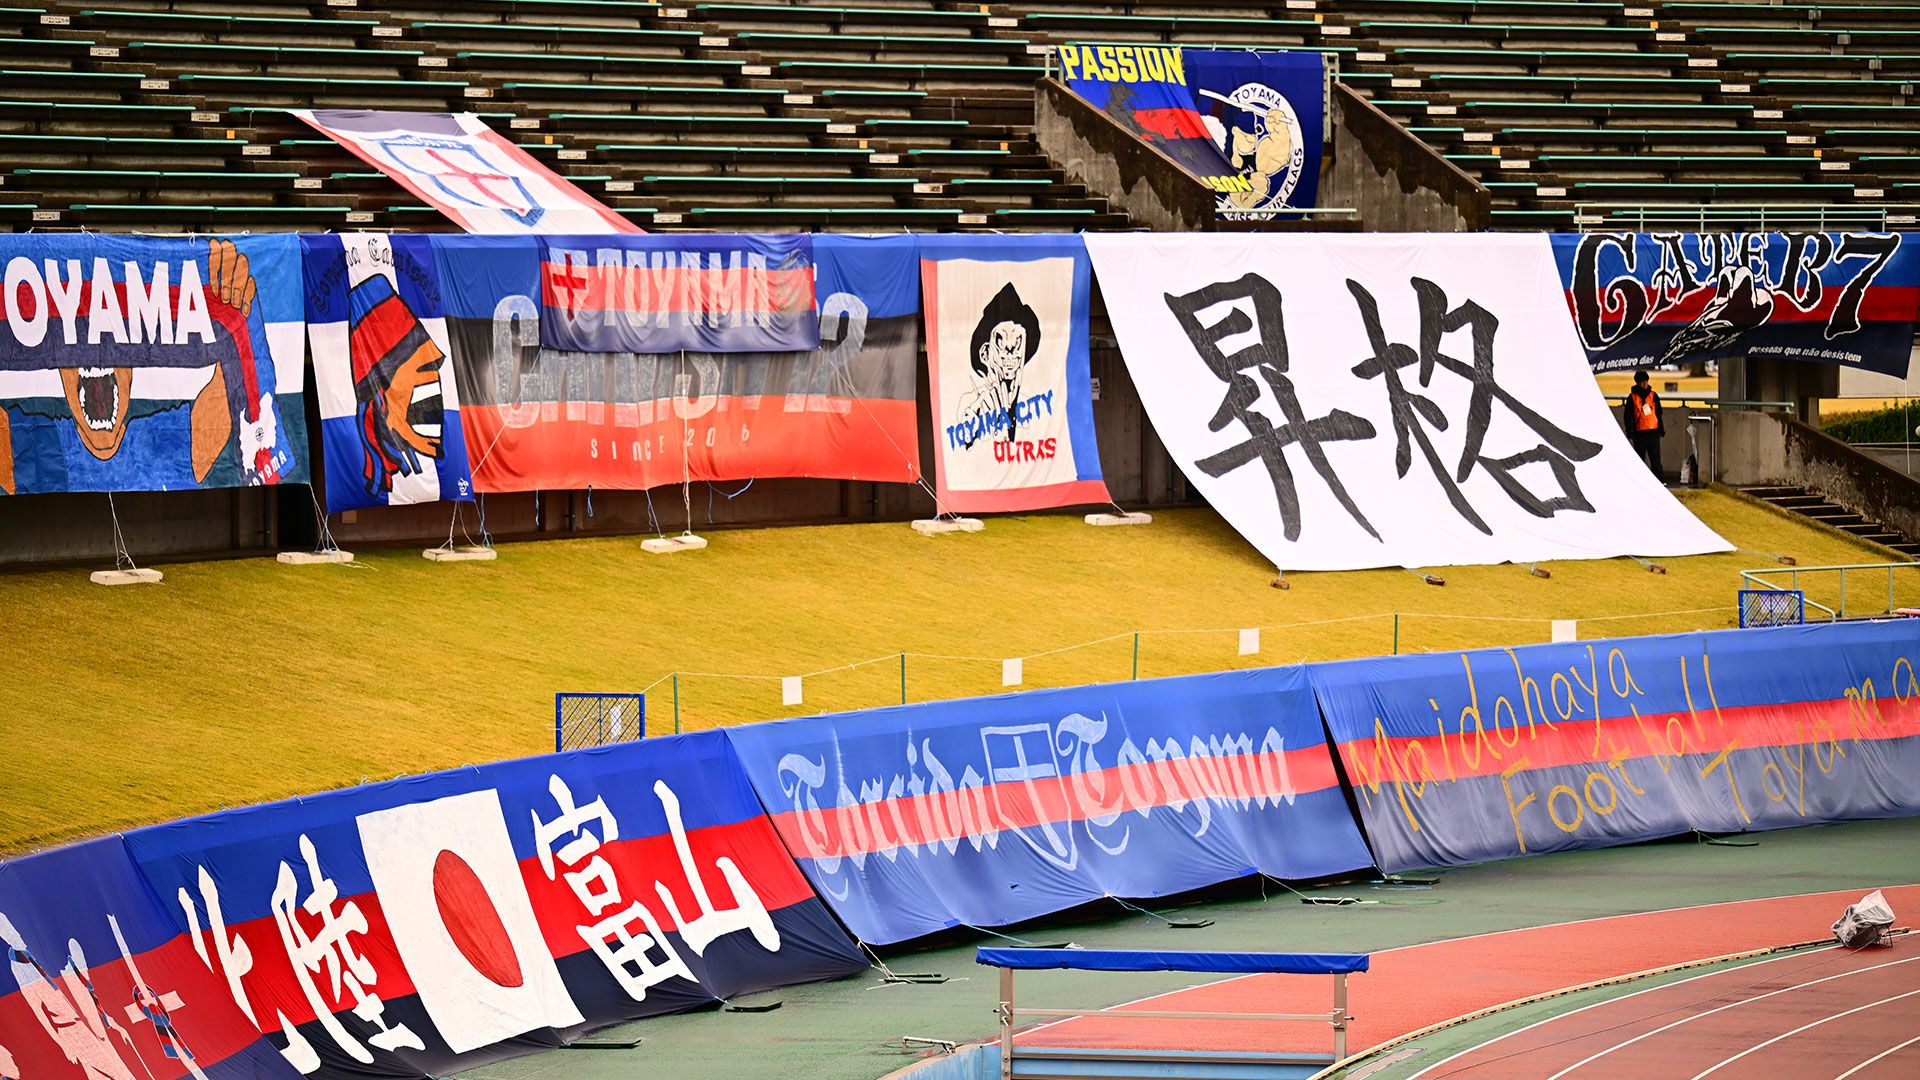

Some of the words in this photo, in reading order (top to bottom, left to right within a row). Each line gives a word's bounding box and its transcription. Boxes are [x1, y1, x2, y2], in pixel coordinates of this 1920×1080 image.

[1059, 44, 1187, 87] PASSION
[1234, 87, 1281, 107] TOYAMA
[1284, 147, 1303, 195] FLAGS
[597, 248, 770, 329] TOYAMA
[1606, 357, 1638, 368] encontro
[1640, 354, 1655, 365] das
[1784, 346, 1801, 356] que
[1802, 347, 1820, 357] não
[946, 406, 1012, 450] TOYAMA
[1014, 389, 1054, 428] CITY
[1163, 271, 1604, 544] 昇格
[1348, 644, 1645, 832] Maidohaya
[1701, 656, 1920, 825] Toyama
[178, 833, 426, 1076] 北陸
[531, 773, 782, 1002] 富山
